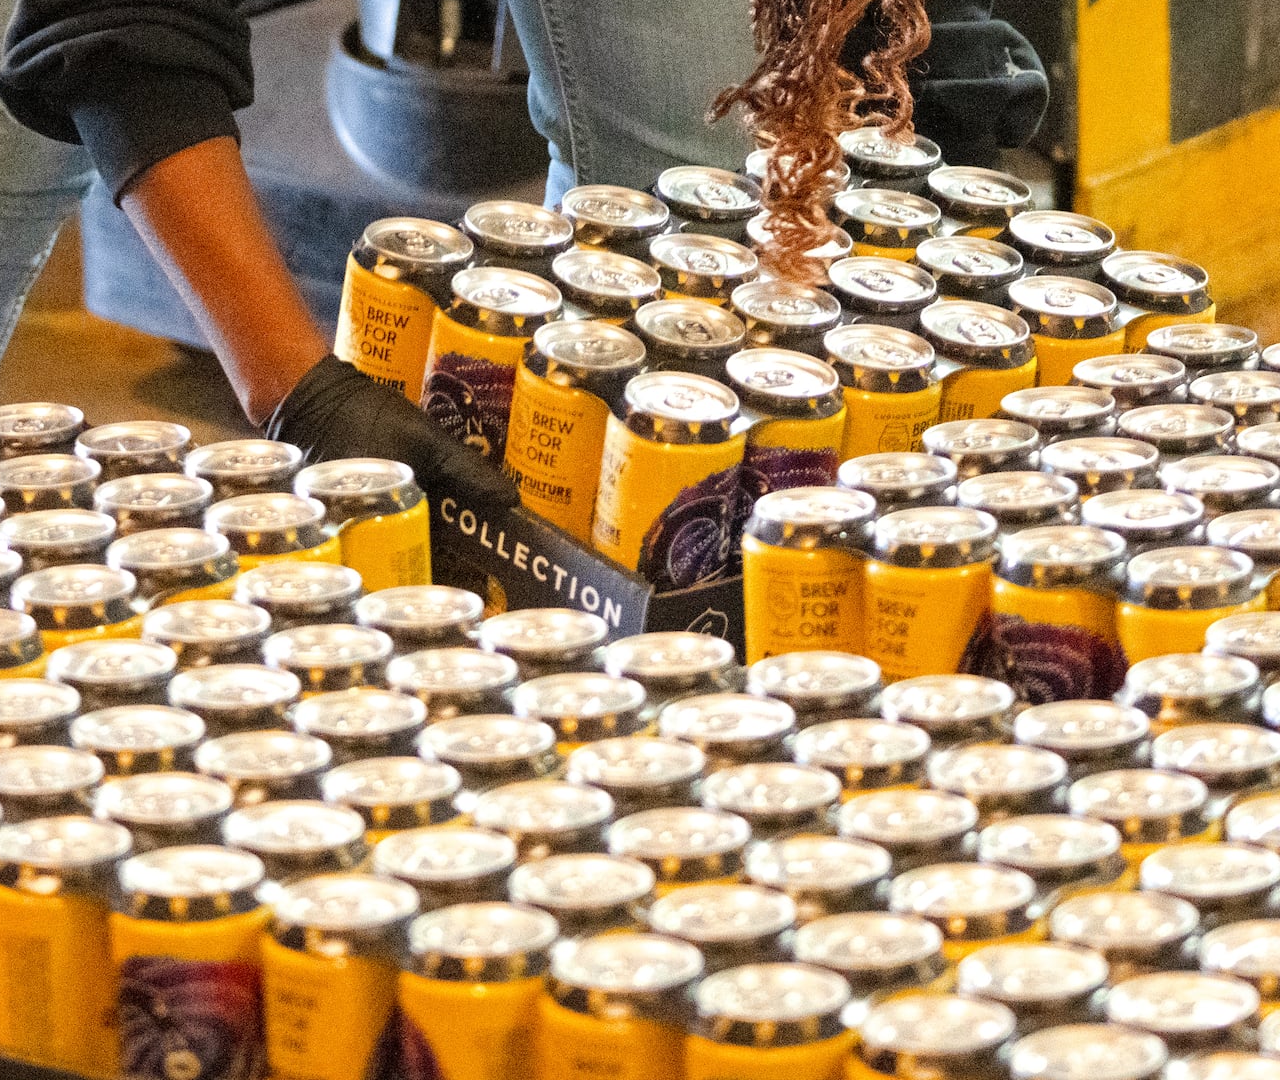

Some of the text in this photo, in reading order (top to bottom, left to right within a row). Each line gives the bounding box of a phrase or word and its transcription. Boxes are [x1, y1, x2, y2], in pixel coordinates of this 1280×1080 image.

[367, 306, 410, 330] BREW
[364, 323, 397, 345] FOR
[360, 341, 393, 362] ONE
[532, 411, 575, 435] BREW
[530, 428, 562, 451] FOR
[526, 446, 559, 468] ONE
[439, 497, 623, 629] COLLECTION
[800, 581, 849, 599] BREW
[800, 600, 840, 618] FOR
[798, 621, 840, 638] ONE
